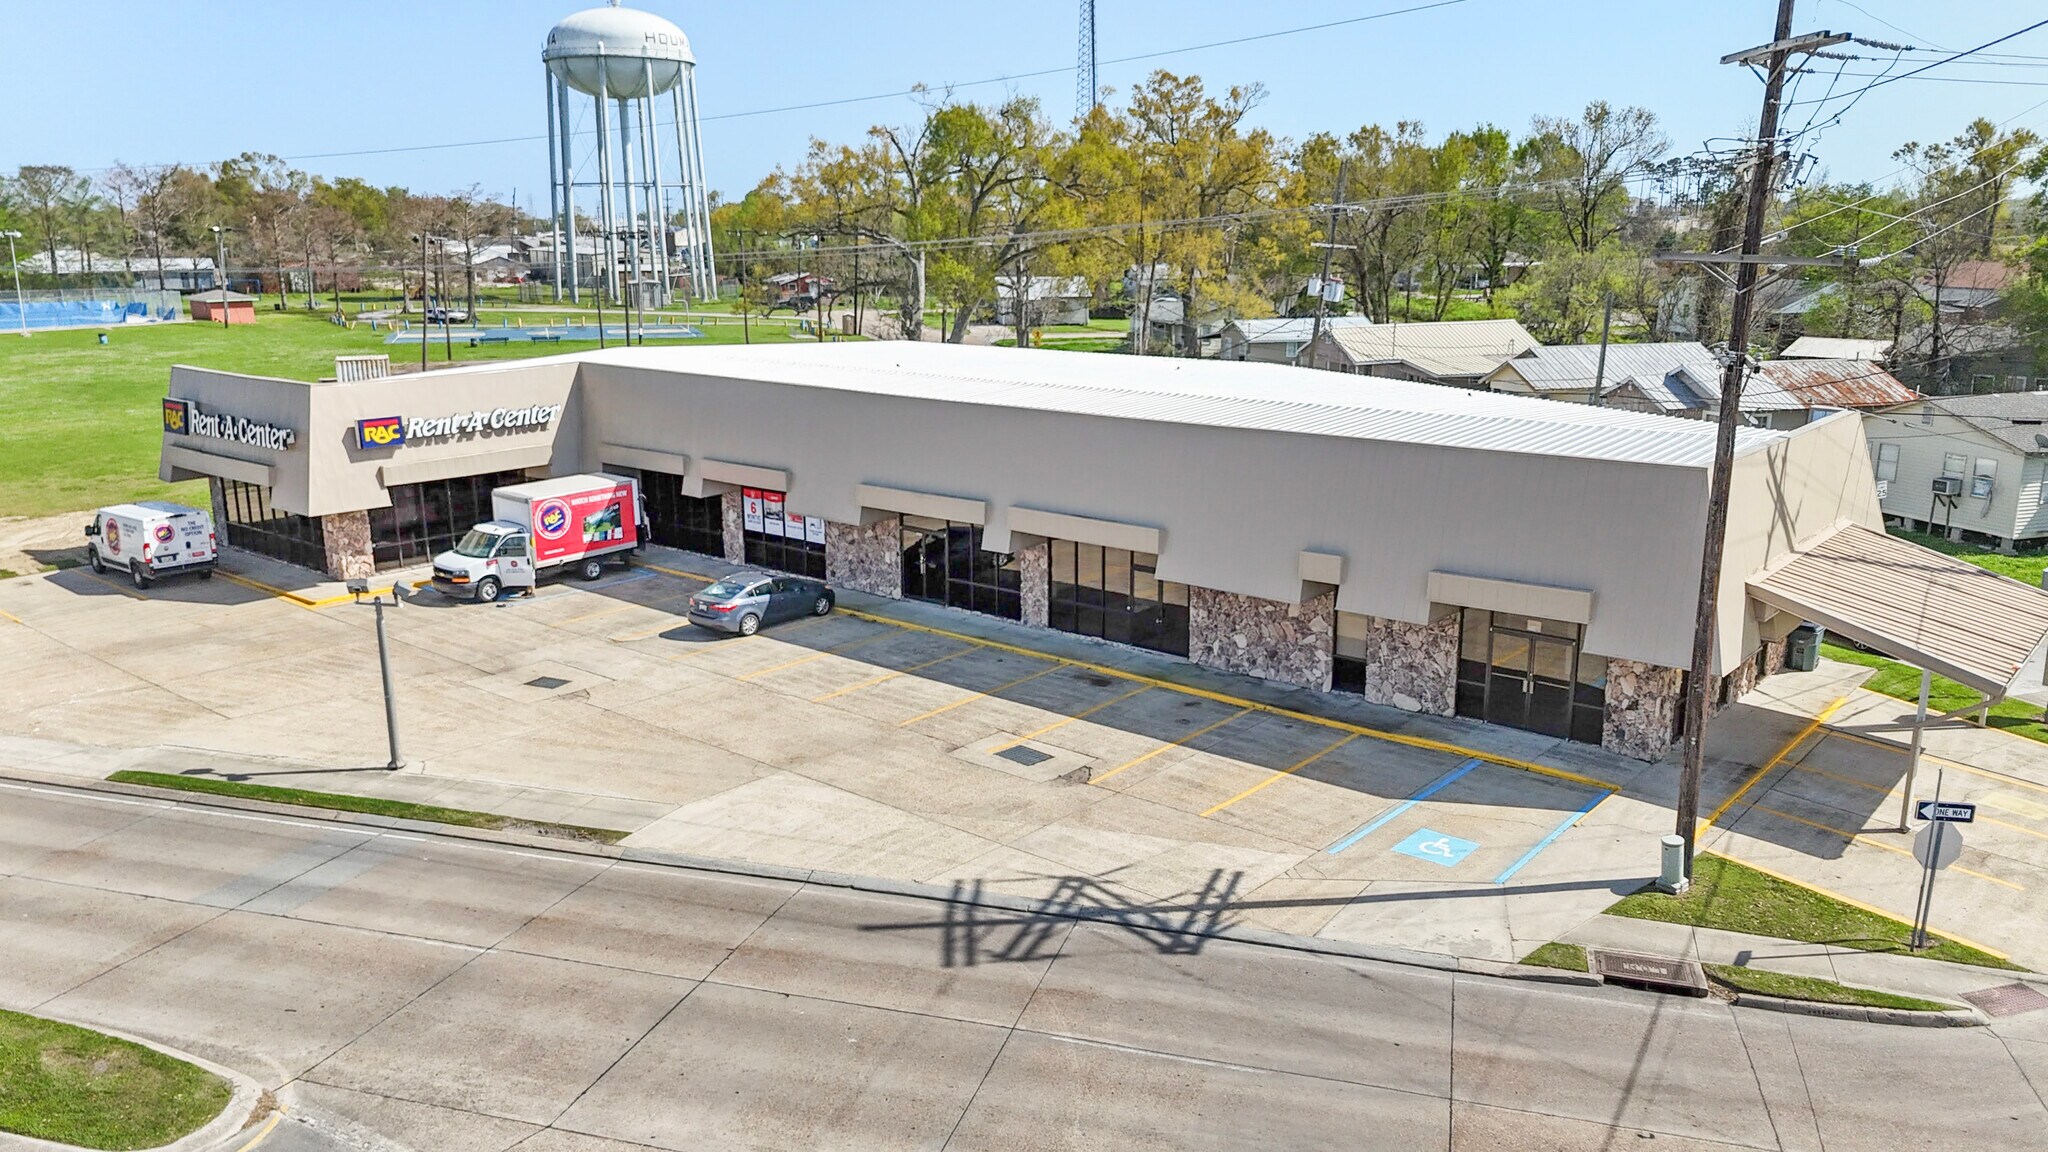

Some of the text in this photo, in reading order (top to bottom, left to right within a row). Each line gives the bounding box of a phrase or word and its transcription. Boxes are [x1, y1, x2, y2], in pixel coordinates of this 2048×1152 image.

[644, 32, 687, 46] HOUM
[165, 408, 184, 430] RAC
[363, 424, 401, 445] RAC
[751, 502, 757, 513] 6
[1952, 809, 1969, 817] WAY
